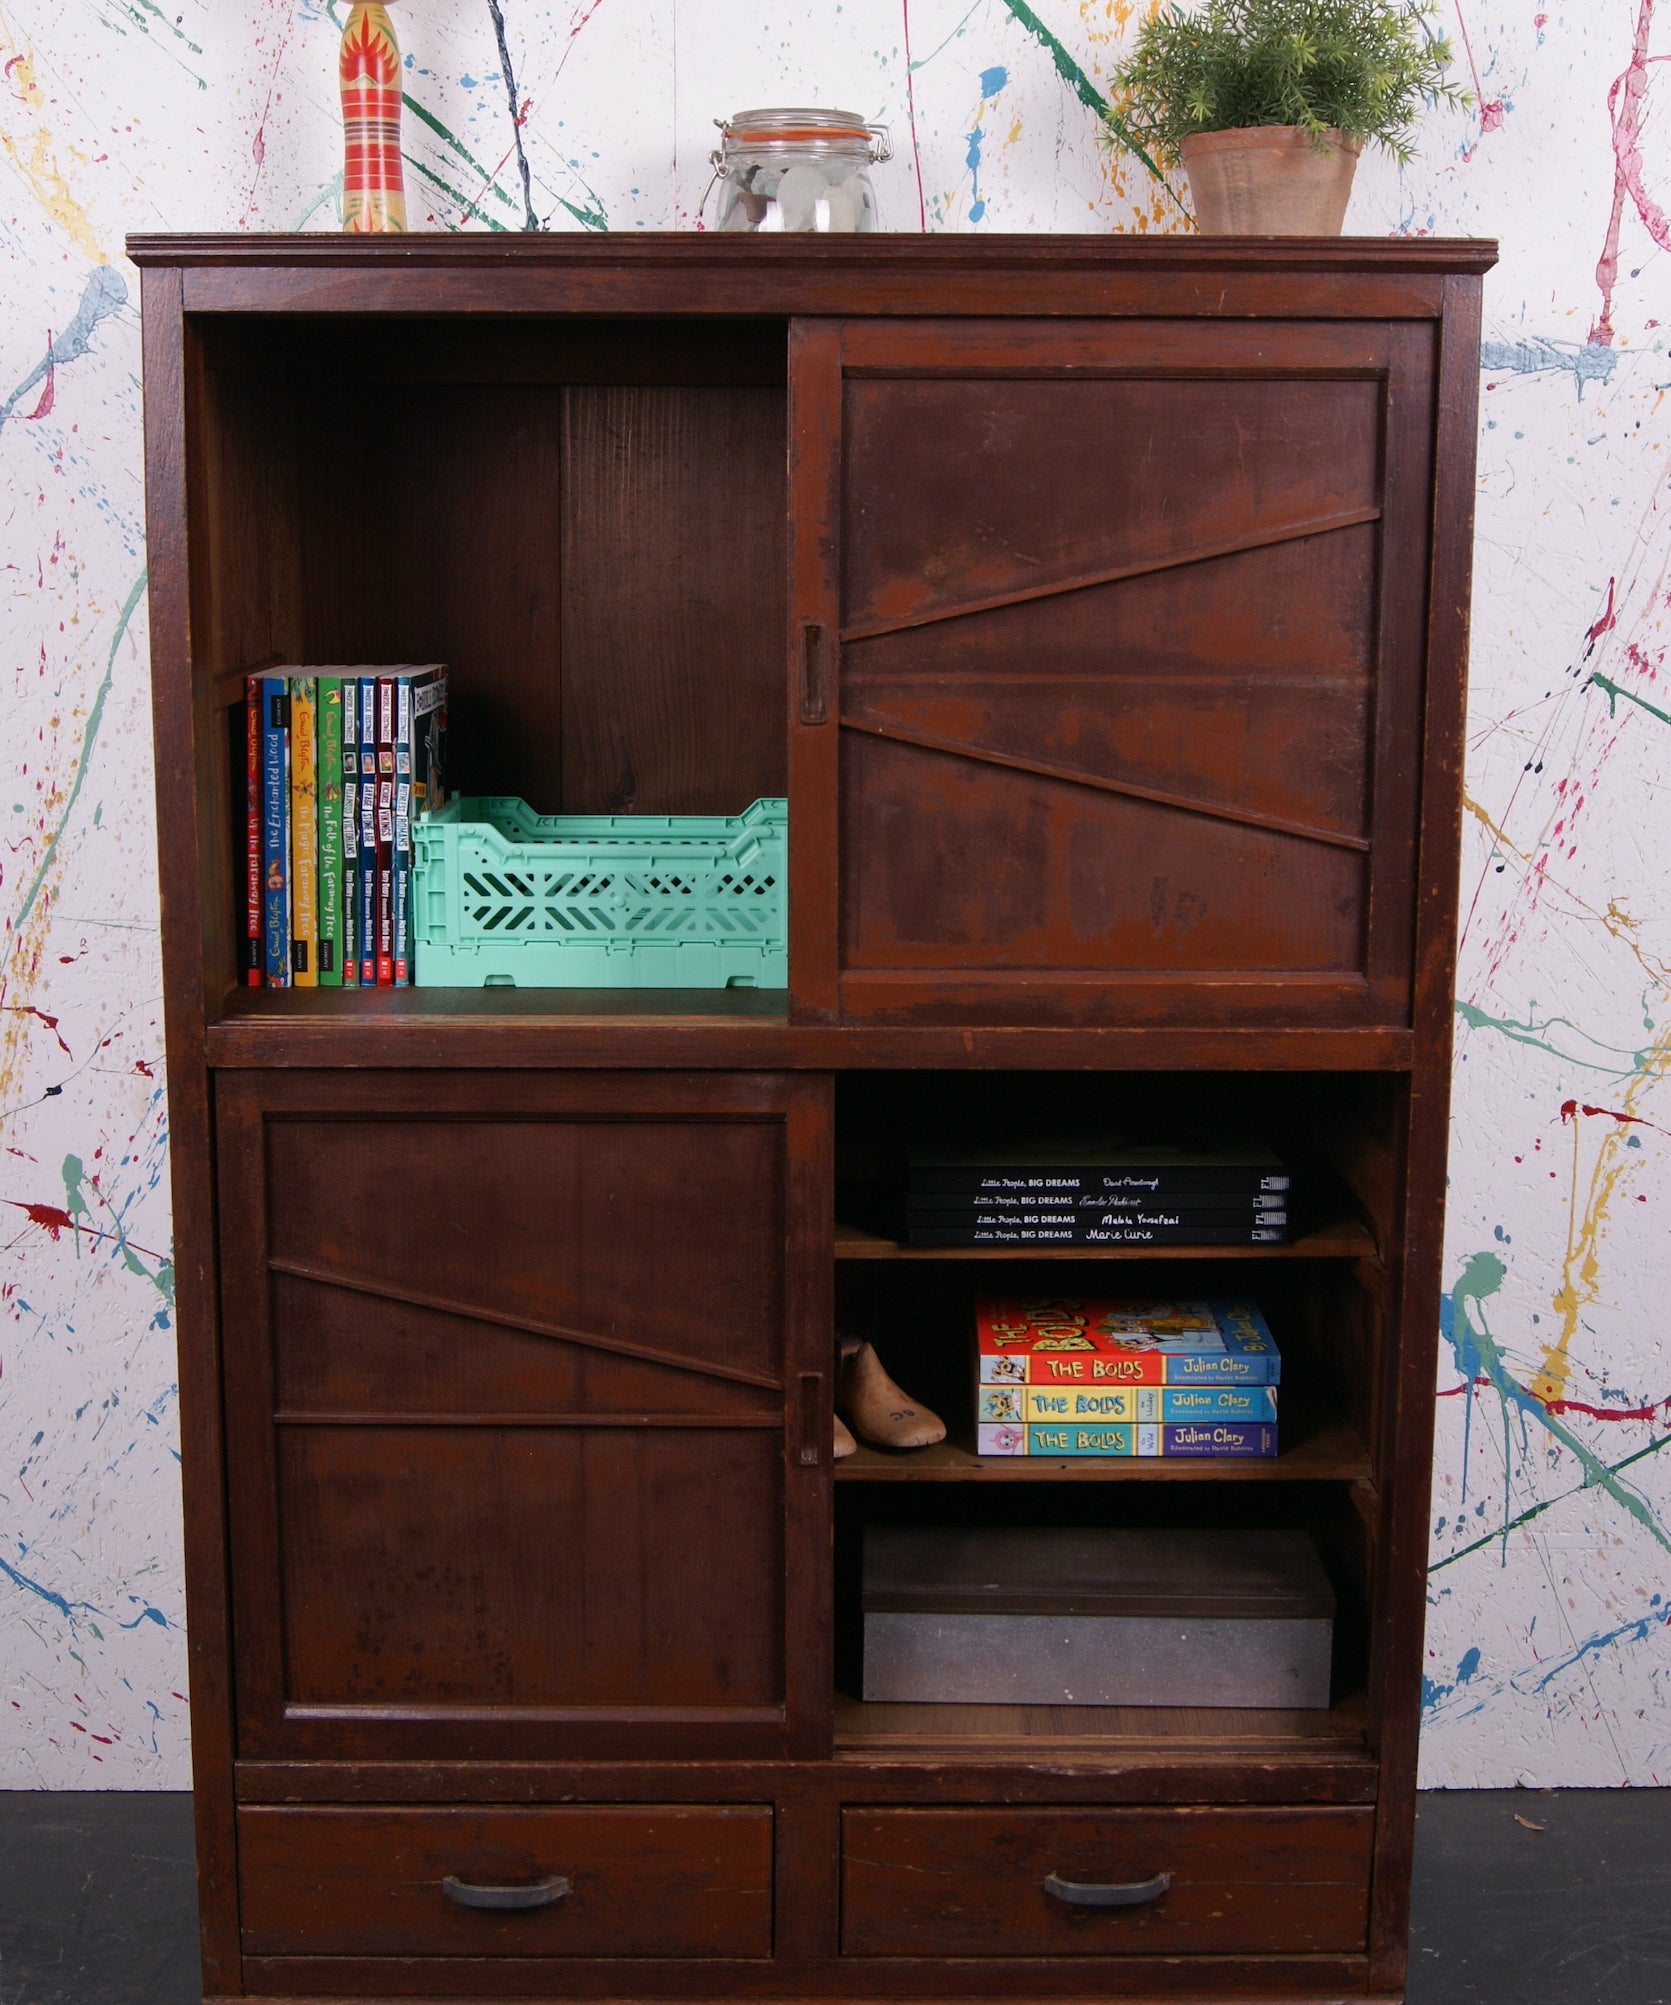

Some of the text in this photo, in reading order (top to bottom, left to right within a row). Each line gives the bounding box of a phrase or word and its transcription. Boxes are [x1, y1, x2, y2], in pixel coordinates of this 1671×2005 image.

[298, 711, 310, 772] Enid Blyton
[325, 711, 337, 771] Enid Blyton
[268, 735, 281, 848] The Enchanted Wood
[326, 820, 337, 842] Folk
[363, 813, 374, 832] STONE
[381, 811, 392, 837] VIKINGS
[397, 818, 409, 847] ROMANS
[250, 836, 260, 850] The
[298, 823, 311, 856] Magic
[344, 819, 356, 855] VICTORIANS
[365, 832, 375, 843] AGE
[322, 843, 335, 854] of
[249, 854, 260, 904] Faraway
[299, 859, 312, 909] Faraway
[323, 872, 336, 912] Faraway
[250, 909, 260, 931] Tree
[300, 913, 311, 936] Tree
[325, 915, 336, 938] Tree
[981, 1179, 1001, 1187] Little
[1028, 1179, 1043, 1187] BIG
[1045, 1179, 1080, 1187] DREAMS
[973, 1196, 993, 1204] Little
[1021, 1196, 1036, 1204] BIG
[1038, 1196, 1073, 1204] DREAMS
[976, 1215, 997, 1224] Little
[1024, 1215, 1039, 1224] BIG
[1041, 1215, 1076, 1224] DREAMS
[974, 1231, 994, 1239] Little
[1021, 1231, 1036, 1239] BIG
[1038, 1231, 1073, 1239] DREAMS
[1086, 1229, 1153, 1240] Marie Curie
[991, 1322, 1031, 1347] THE
[1021, 1299, 1097, 1351] BOLDS
[1046, 1359, 1144, 1380] THE BOLDS
[1183, 1357, 1218, 1373] Julian
[1220, 1358, 1250, 1374] Clary
[1032, 1394, 1126, 1415] THE BOLDS
[1172, 1393, 1212, 1407] Julian
[1218, 1393, 1251, 1408] Clary
[1033, 1430, 1125, 1451] THE BOLDS
[1175, 1427, 1245, 1446] Julian Clary
